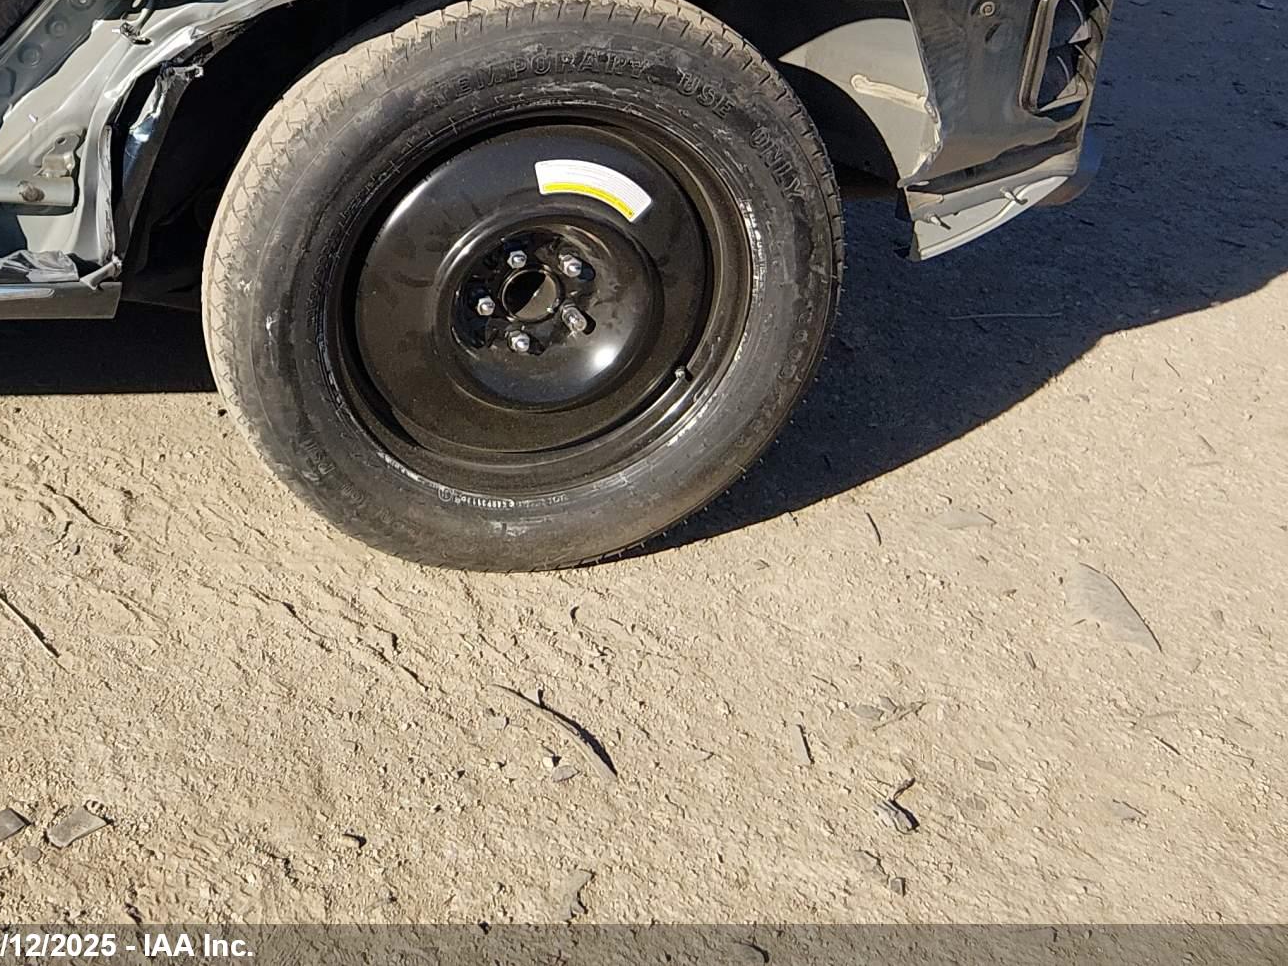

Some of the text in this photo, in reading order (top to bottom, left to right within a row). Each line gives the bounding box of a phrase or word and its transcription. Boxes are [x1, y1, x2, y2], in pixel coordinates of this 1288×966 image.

[430, 47, 807, 202] TEMPORARY USE ONLY
